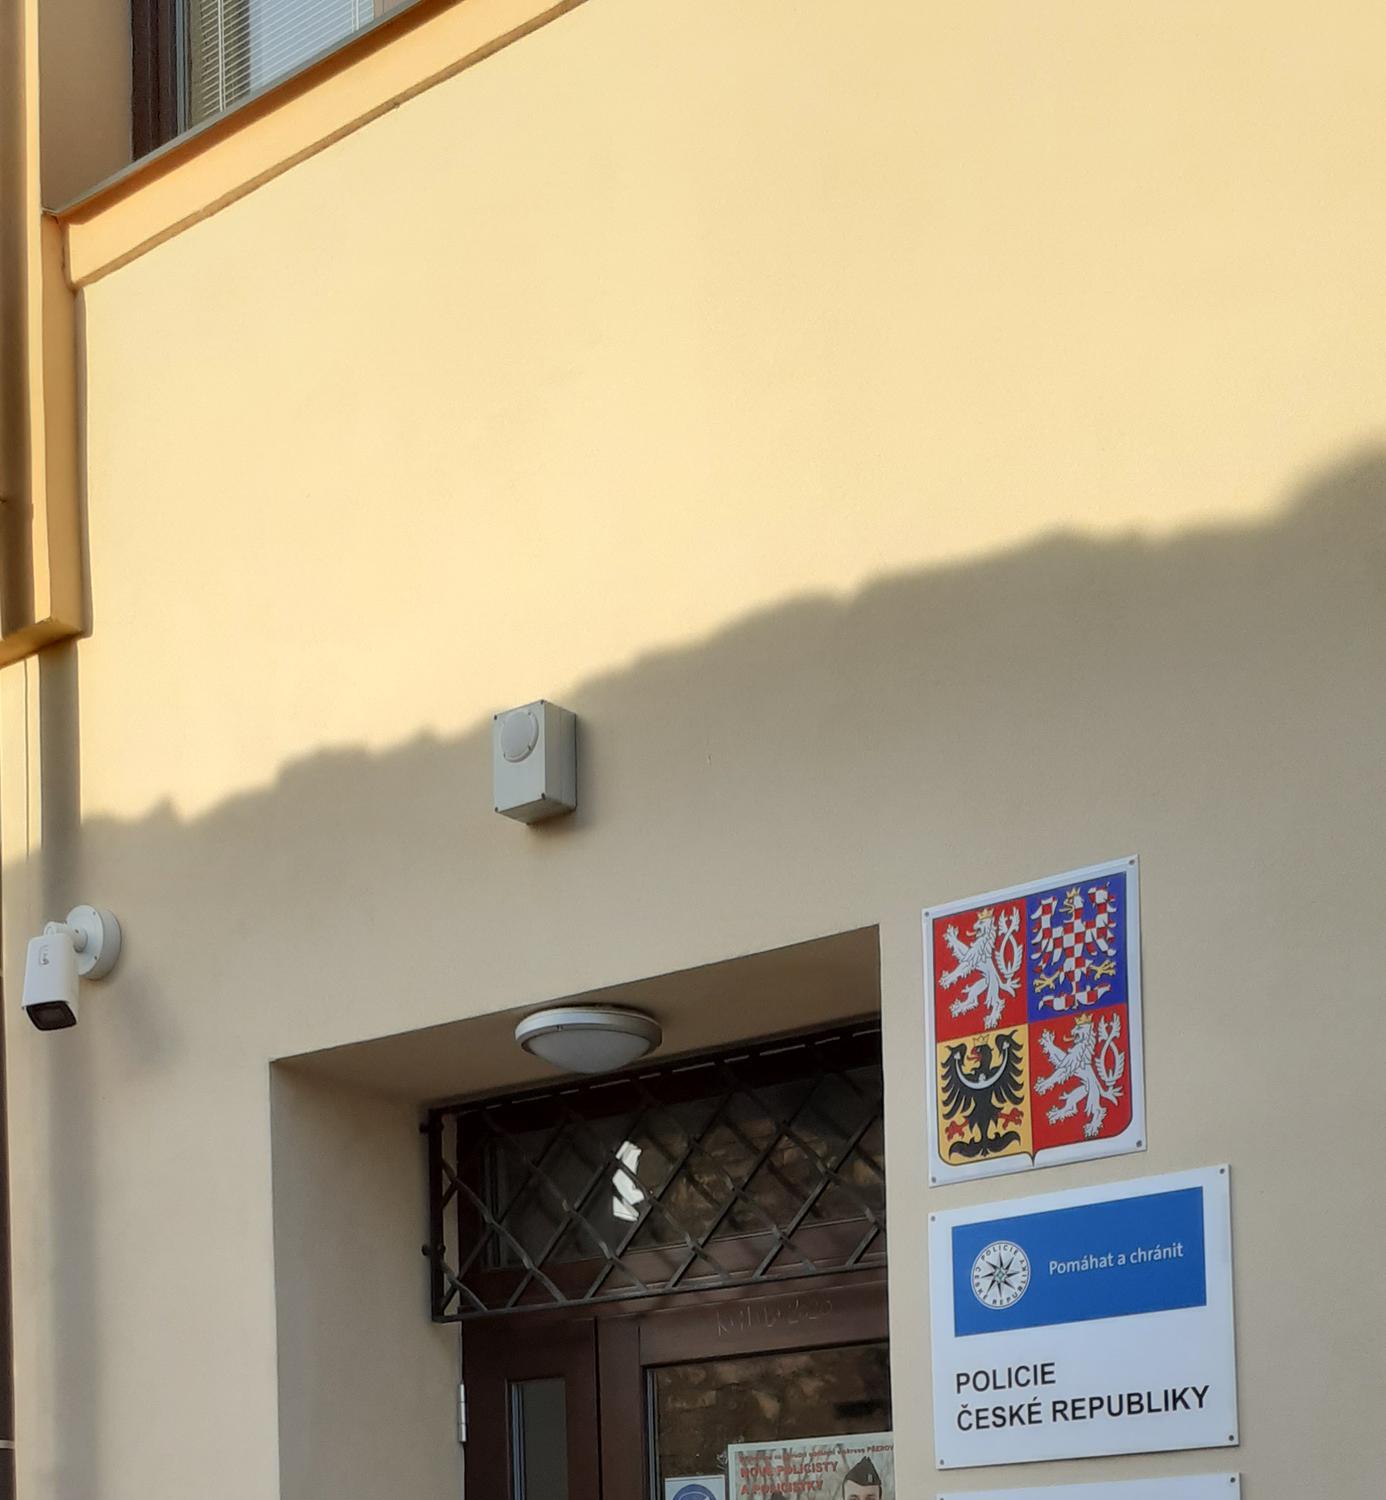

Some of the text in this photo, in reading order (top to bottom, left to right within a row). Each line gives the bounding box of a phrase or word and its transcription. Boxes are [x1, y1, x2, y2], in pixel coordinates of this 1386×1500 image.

[1048, 1242, 1184, 1276] Pomáhat a chránit
[956, 1362, 1056, 1394] POLICIE
[957, 1385, 1210, 1432] ČESKÉ REPUBLIKY
